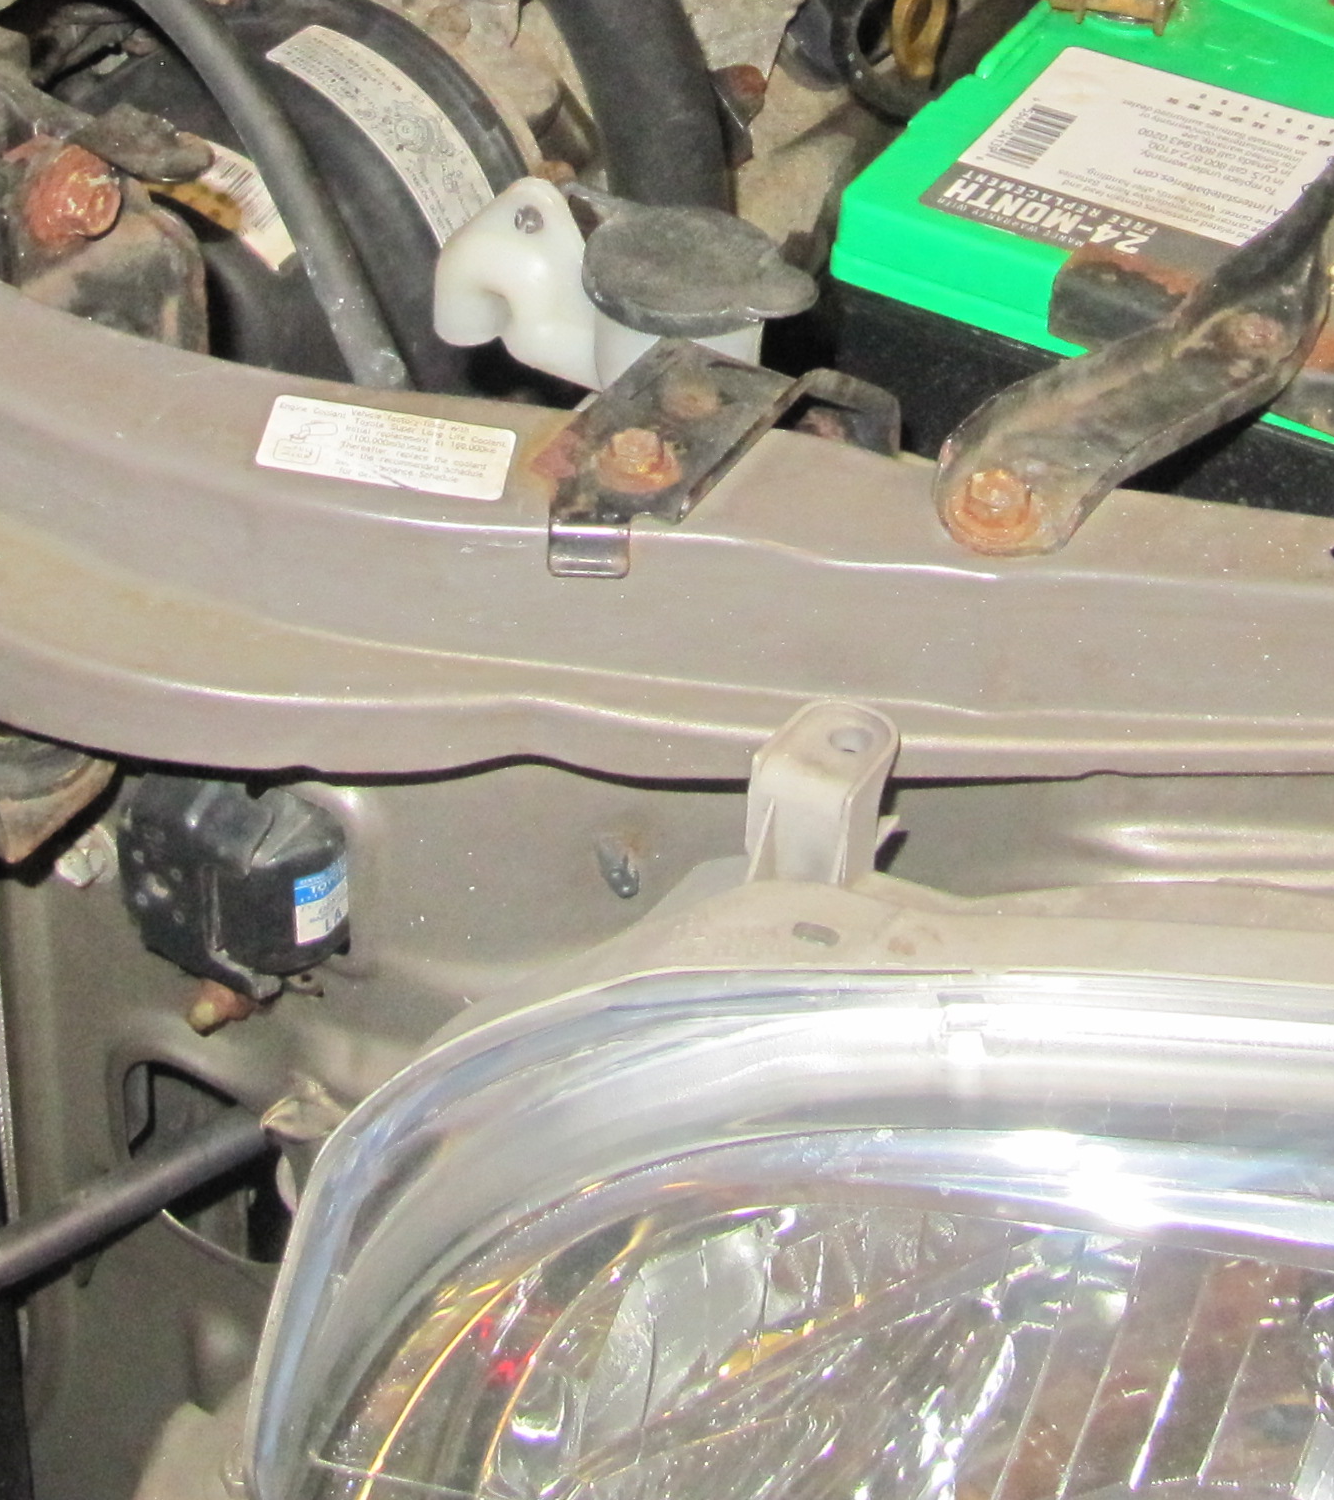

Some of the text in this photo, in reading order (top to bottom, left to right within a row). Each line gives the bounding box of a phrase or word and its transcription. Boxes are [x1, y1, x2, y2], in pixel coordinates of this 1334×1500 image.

[1185, 164, 1223, 178] under
[1234, 156, 1279, 174] Canada
[1129, 165, 1268, 212] interstatebatteries.com
[1261, 185, 1278, 195] To
[960, 169, 1159, 235] FREE REPLACEMENT
[940, 177, 1151, 255] 24-MONTH
[349, 407, 382, 419] Vehicle
[354, 417, 384, 428] Toyota
[470, 435, 507, 447] Coolant
